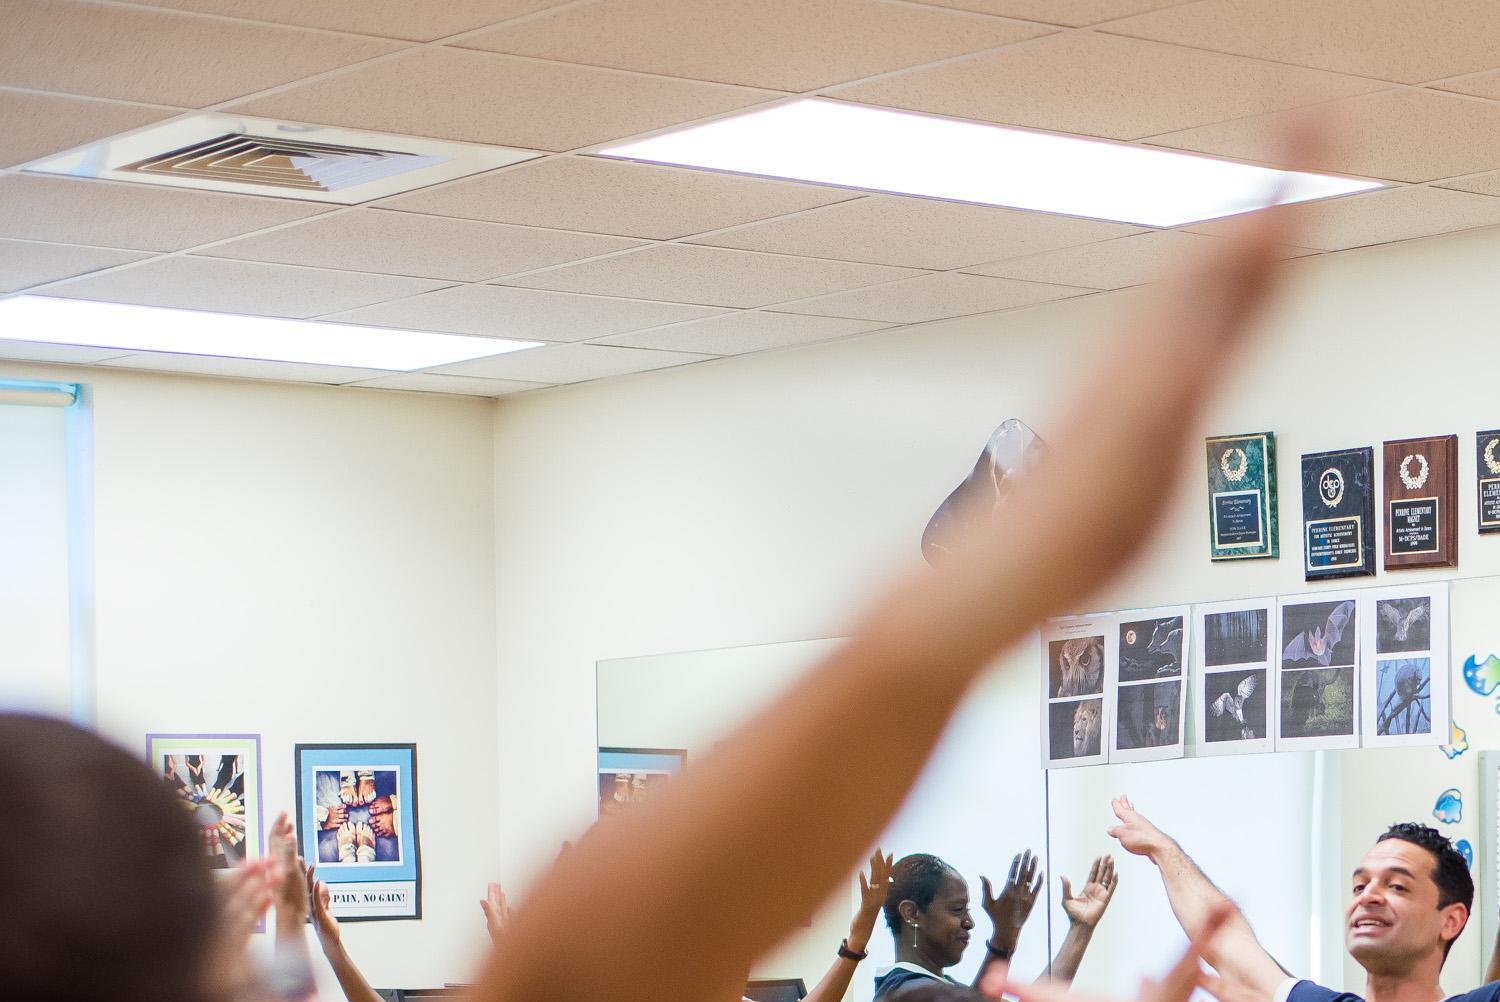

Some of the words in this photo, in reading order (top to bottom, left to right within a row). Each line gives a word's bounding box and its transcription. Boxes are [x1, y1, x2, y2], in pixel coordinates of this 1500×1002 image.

[1396, 508, 1409, 516] PERRINE
[1411, 506, 1431, 515] ELEMENTARY
[1407, 515, 1420, 523] MAGNET
[334, 894, 360, 903] PAIN,
[364, 894, 376, 902] NO
[379, 893, 405, 902] GAIN!
